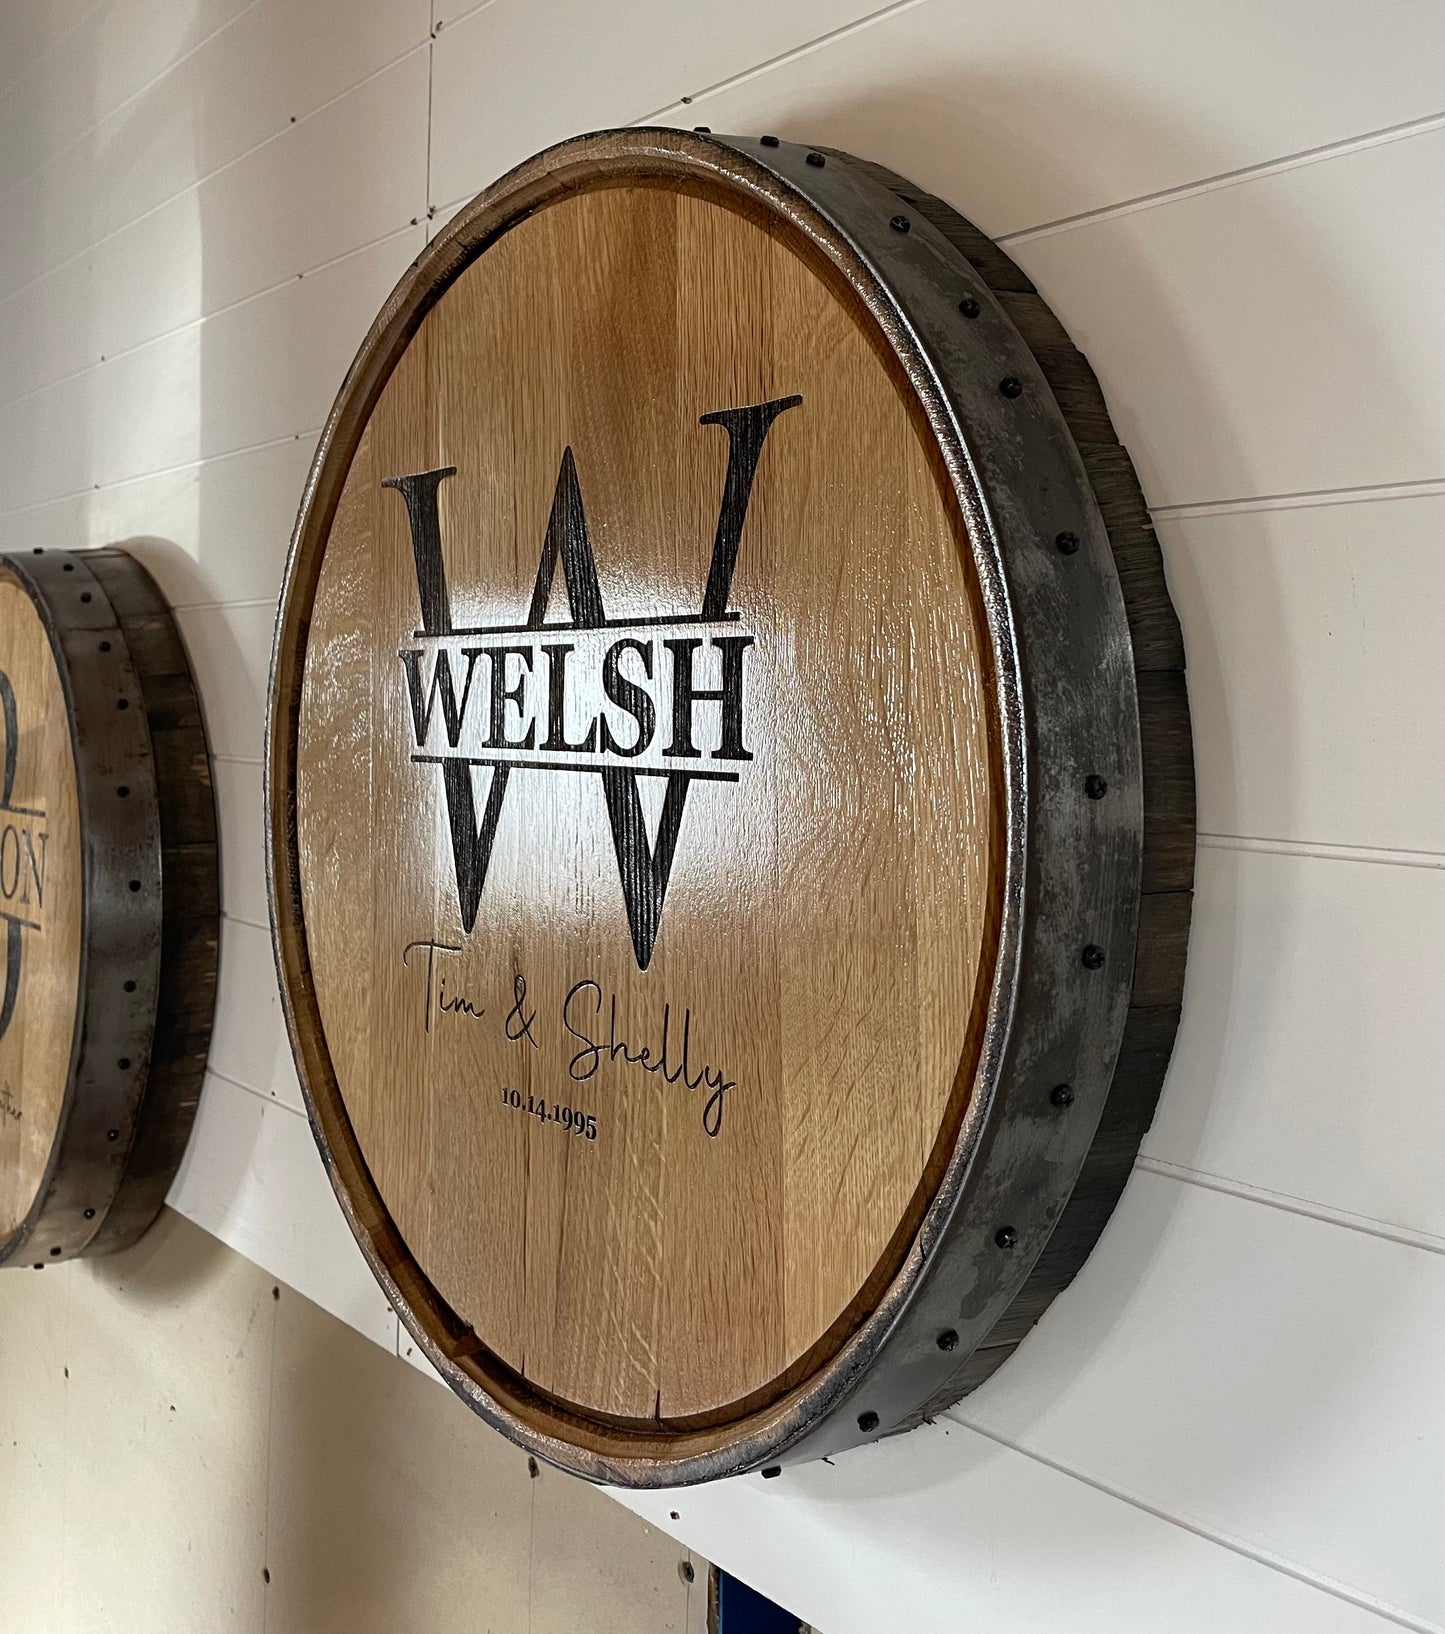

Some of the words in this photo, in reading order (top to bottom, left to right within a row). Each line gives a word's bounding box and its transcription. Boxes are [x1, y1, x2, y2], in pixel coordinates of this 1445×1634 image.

[382, 394, 802, 971] W
[398, 635, 754, 761] WELSH
[403, 938, 485, 1033] Tim
[505, 974, 539, 1049] &
[563, 979, 736, 1137] Shelly
[502, 1086, 598, 1140] 10.14.1995
